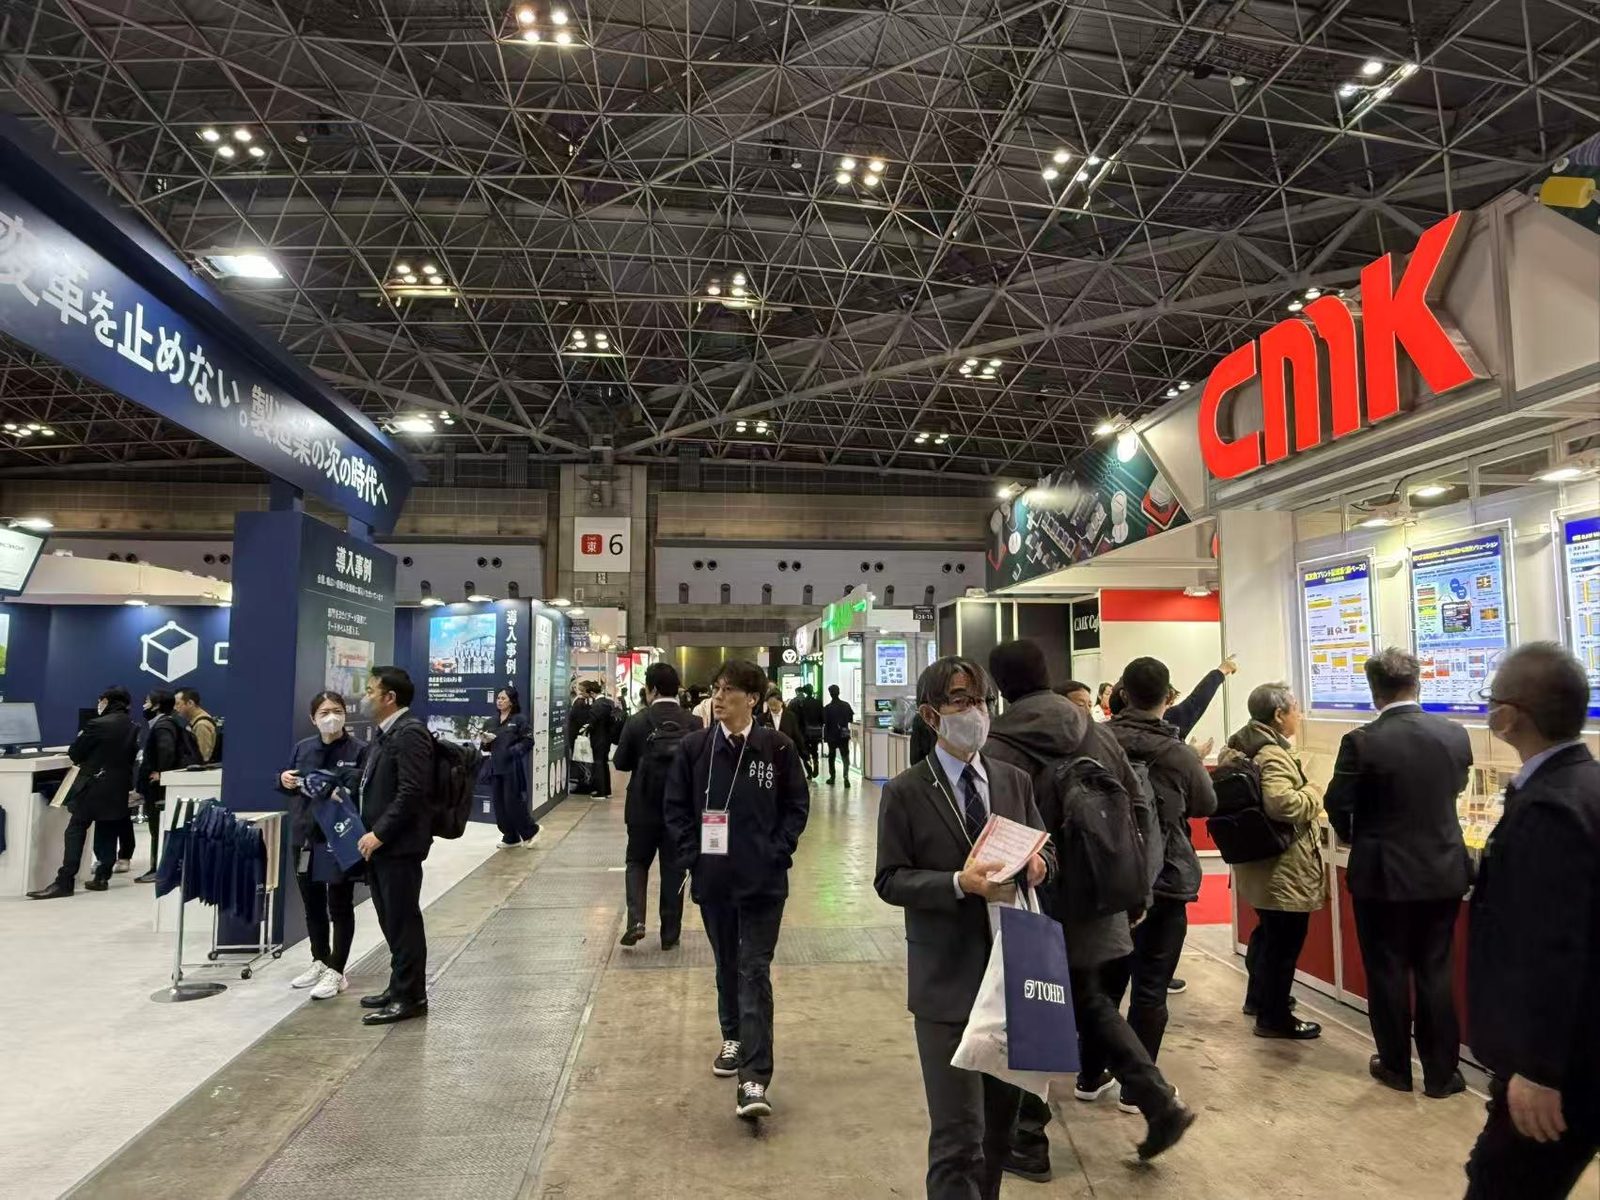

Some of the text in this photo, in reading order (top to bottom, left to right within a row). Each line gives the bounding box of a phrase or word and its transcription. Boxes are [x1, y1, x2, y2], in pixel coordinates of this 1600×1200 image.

[1198, 210, 1475, 481] CMK
[587, 533, 624, 556] 東 6
[335, 545, 373, 584] 導入事例
[505, 609, 518, 675] 導入事例
[749, 760, 774, 772] ARA
[1034, 980, 1066, 1005] TOHEI
